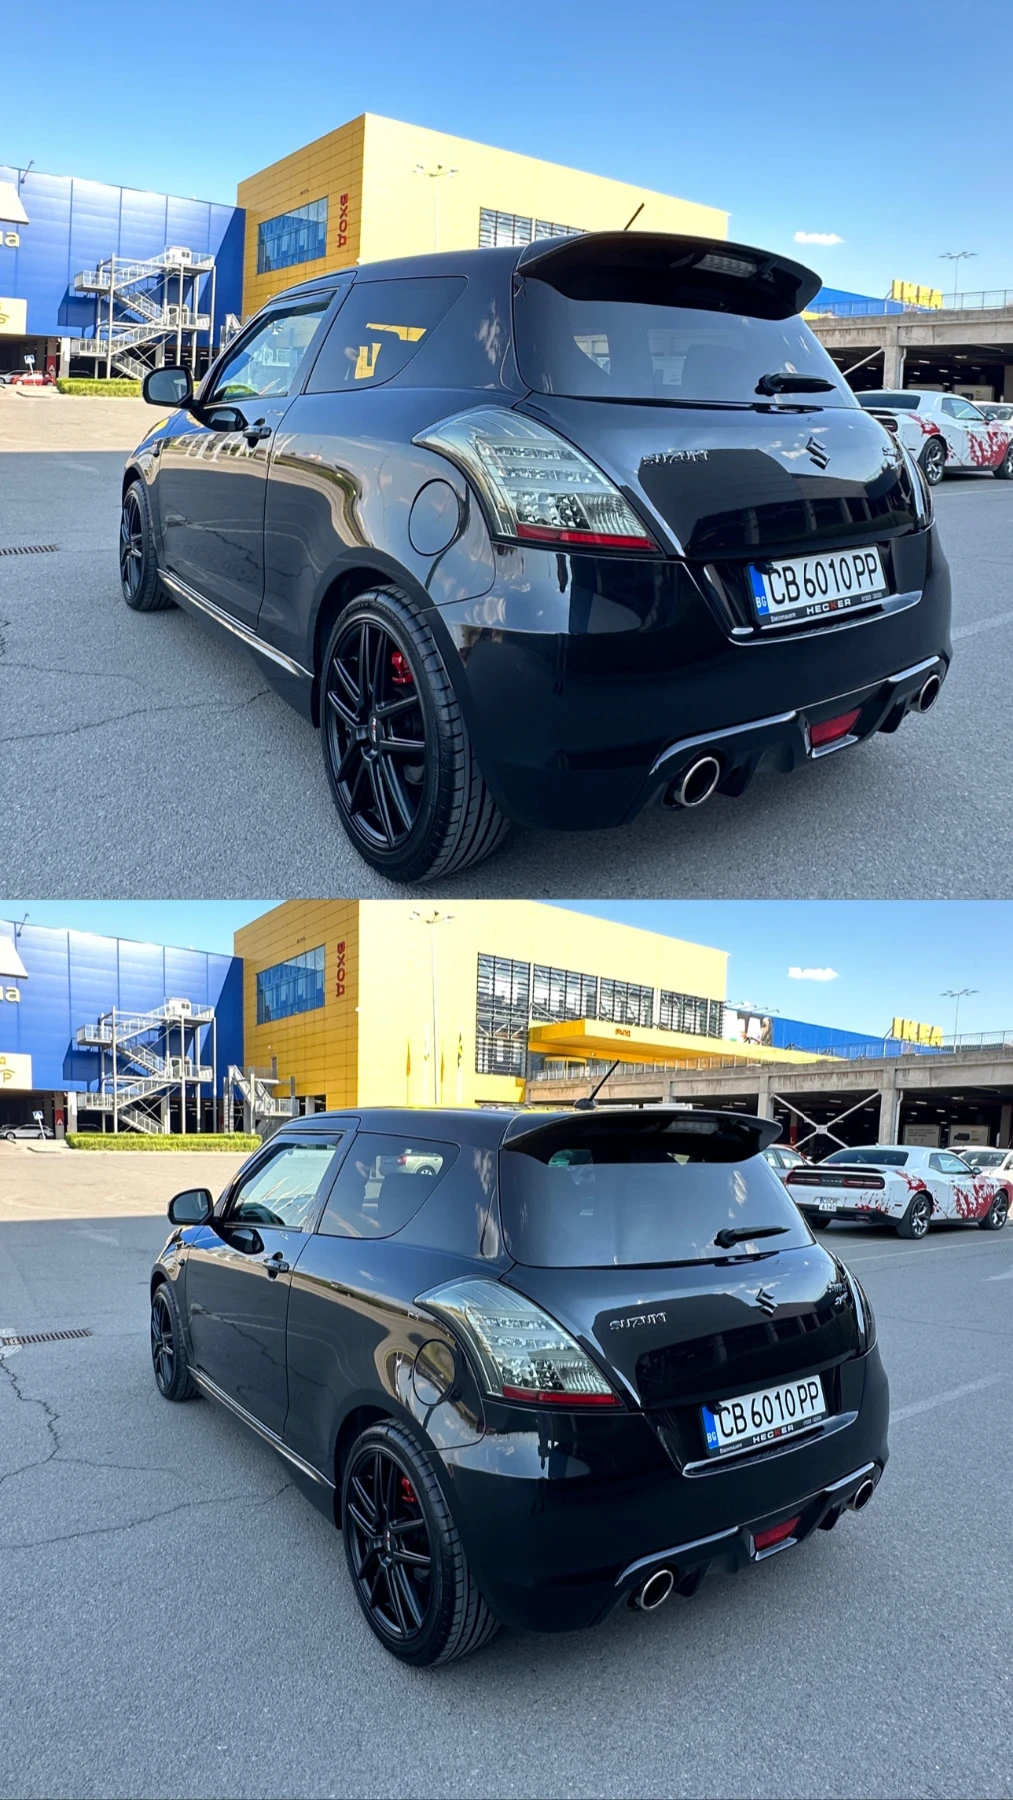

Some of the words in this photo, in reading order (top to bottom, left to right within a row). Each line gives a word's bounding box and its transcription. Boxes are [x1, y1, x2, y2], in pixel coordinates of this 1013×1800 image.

[337, 193, 348, 248] ВХОД
[642, 450, 708, 466] SUZUKI
[755, 596, 767, 608] BG
[806, 598, 851, 615] HECKER
[336, 941, 345, 997] ВХОД
[610, 1312, 666, 1330] SUZUKI
[706, 1432, 717, 1443] BG
[752, 1424, 794, 1444] HECKER
